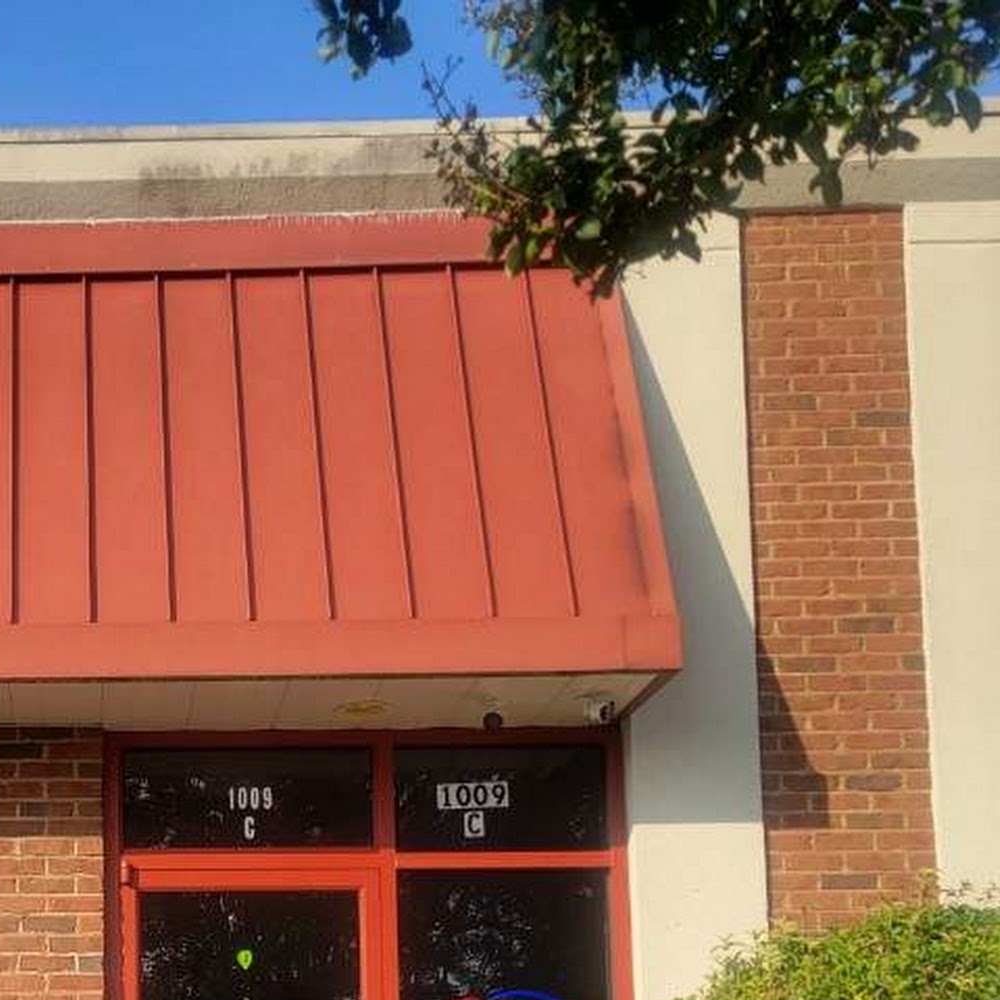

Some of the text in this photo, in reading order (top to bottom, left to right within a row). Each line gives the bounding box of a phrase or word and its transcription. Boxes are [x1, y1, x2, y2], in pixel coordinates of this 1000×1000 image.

[228, 787, 273, 810] 1009
[442, 783, 506, 807] 1009
[467, 812, 482, 835] C
